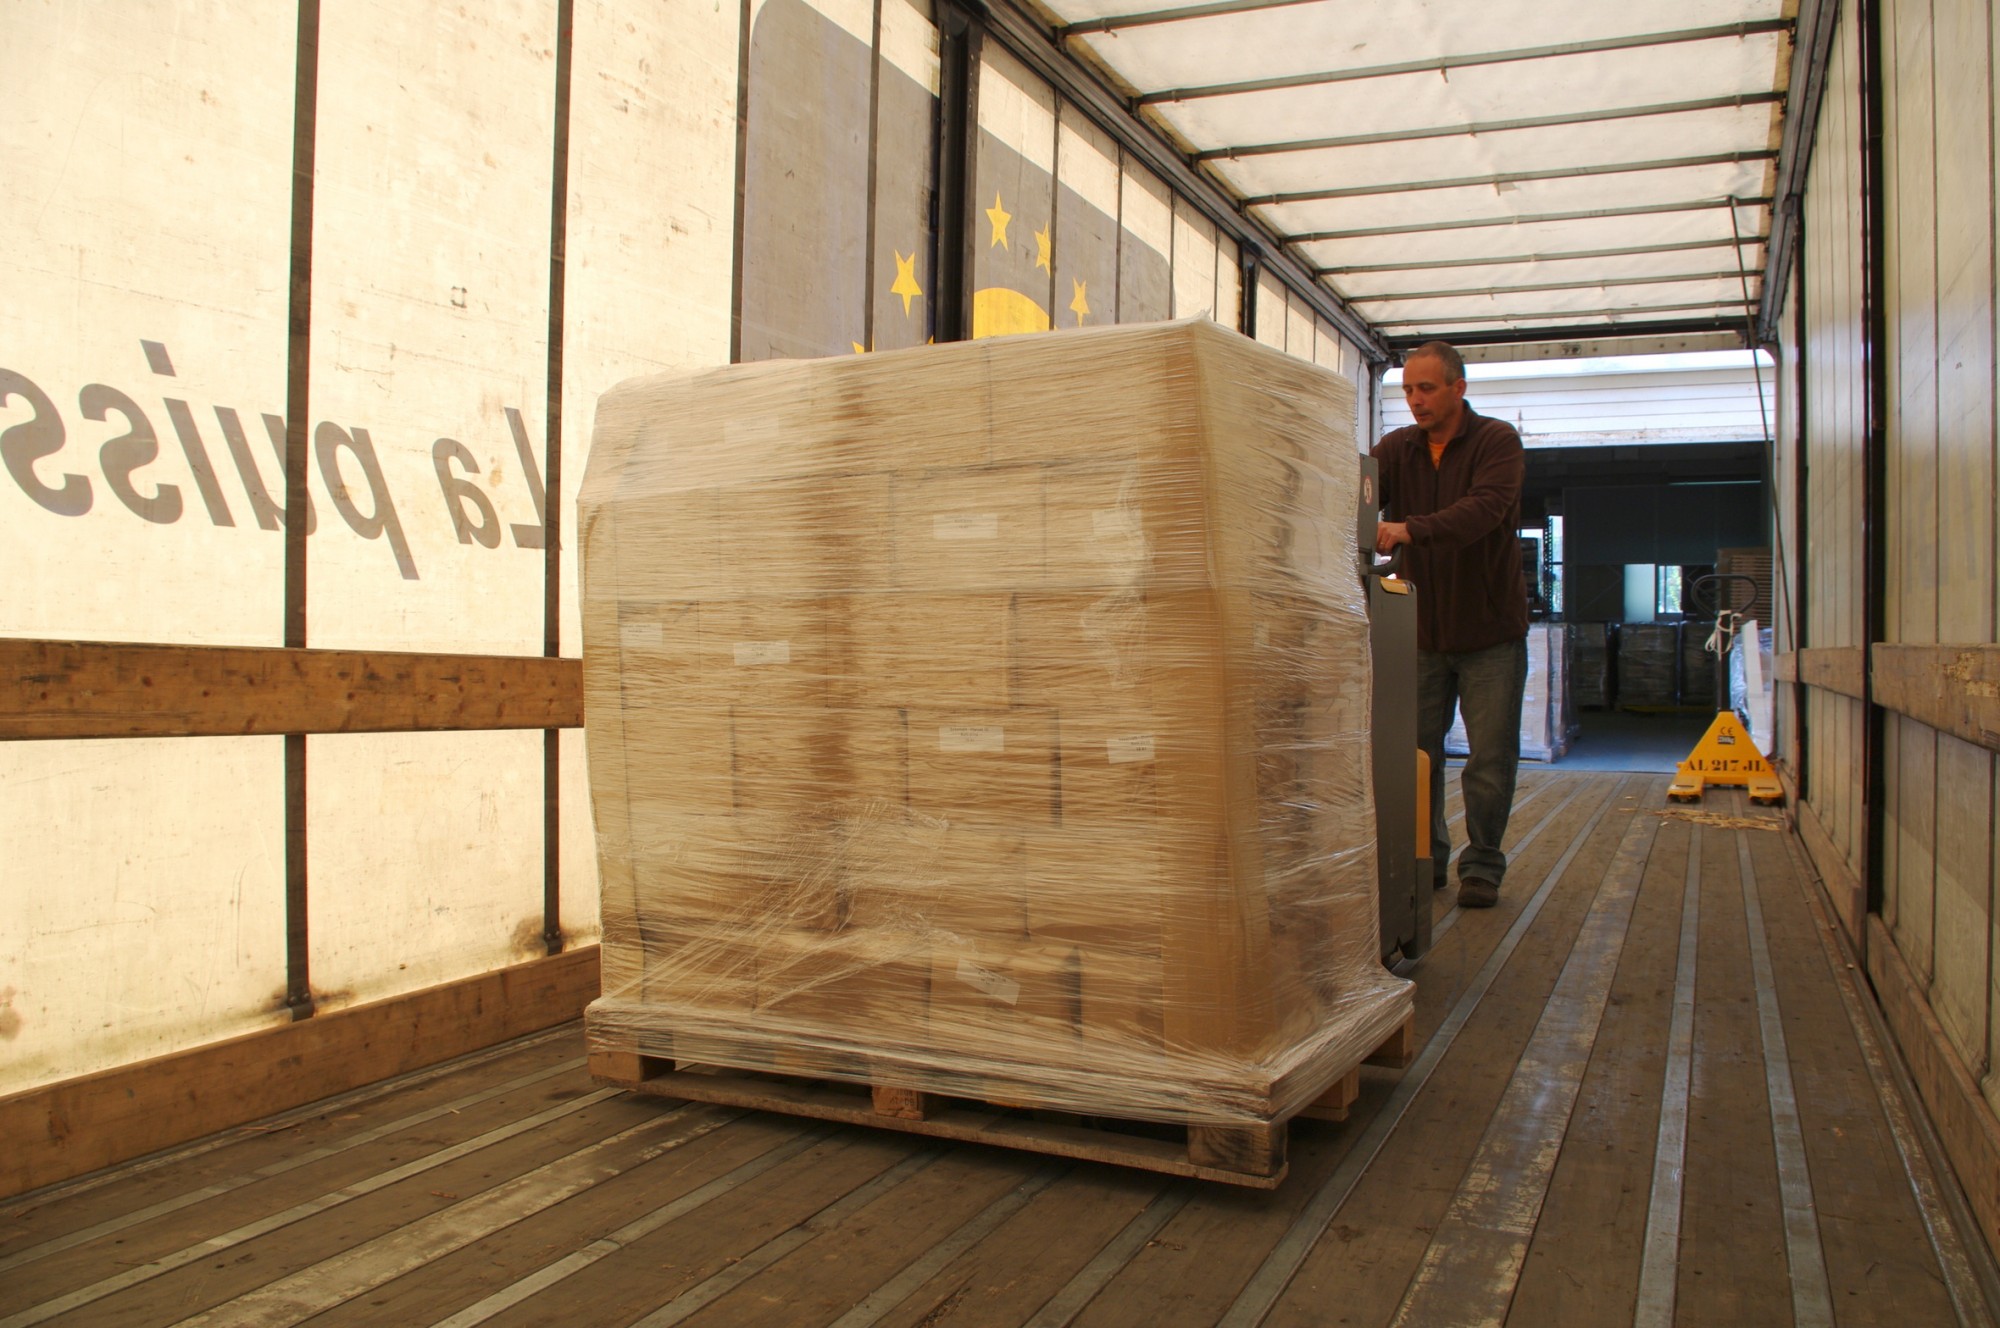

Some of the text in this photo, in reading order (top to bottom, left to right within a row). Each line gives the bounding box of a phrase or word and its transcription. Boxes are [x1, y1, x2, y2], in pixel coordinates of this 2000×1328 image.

[1720, 726, 1733, 736] CE
[1686, 759, 1708, 771] AL
[1712, 759, 1739, 771] 217
